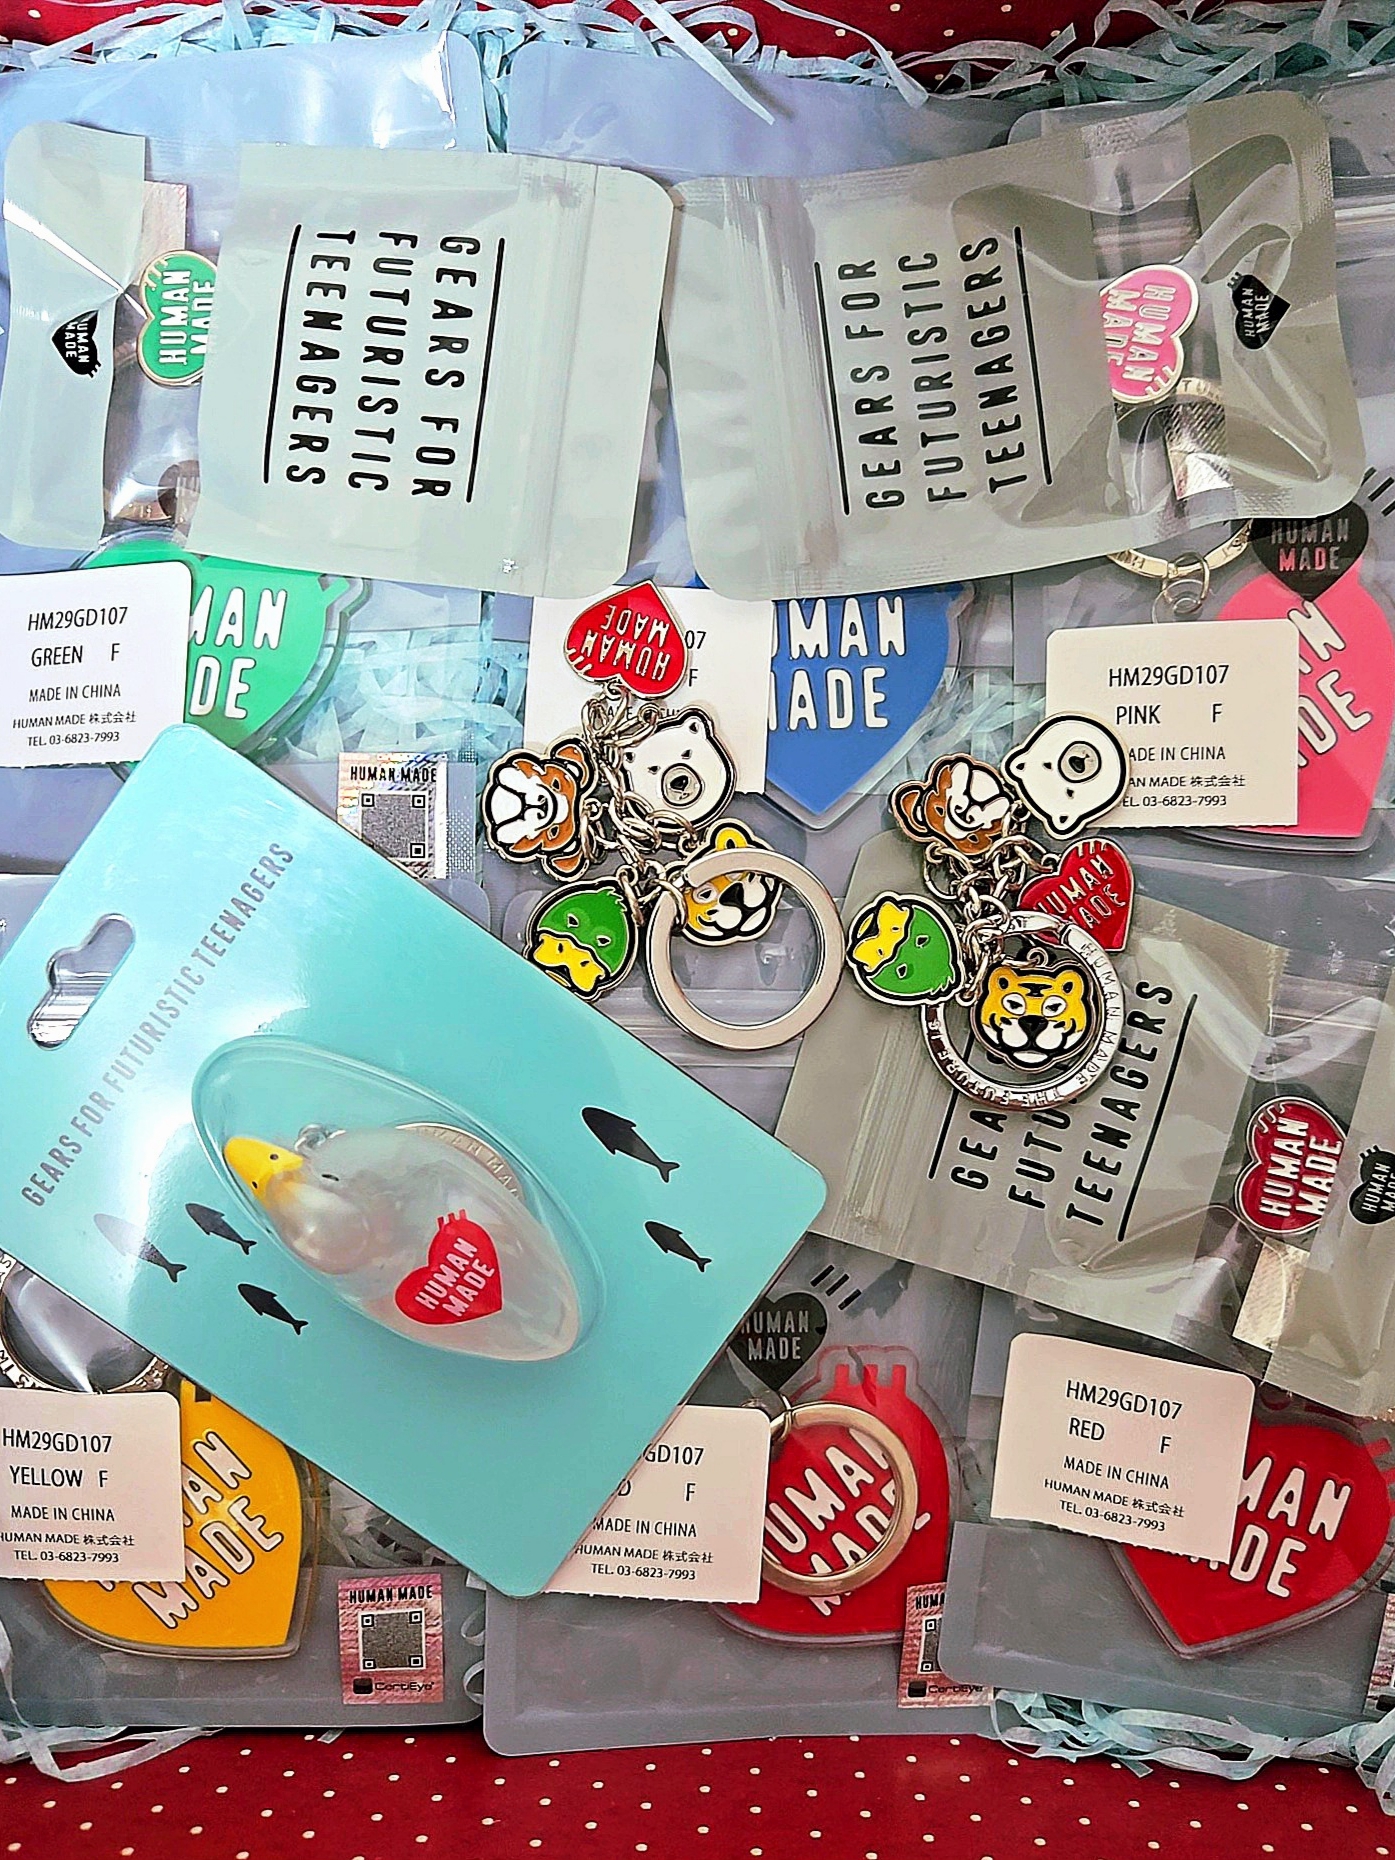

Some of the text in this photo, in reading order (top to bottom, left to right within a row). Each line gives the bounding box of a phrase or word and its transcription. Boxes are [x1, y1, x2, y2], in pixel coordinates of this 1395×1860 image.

[159, 271, 192, 364] HUMAN
[1241, 288, 1256, 337] HUMAN
[1254, 295, 1271, 334] MADE
[1122, 284, 1176, 382] HUMAN
[286, 230, 356, 484] TEENAGERS
[348, 231, 418, 491] FUTURISTIC
[412, 236, 480, 497] GEARS FOR
[959, 237, 1027, 494] TEENAGERS
[838, 260, 905, 509] GEARS FOR
[898, 252, 967, 502] FUTURISTIC
[1270, 517, 1349, 545] HUMAN
[1278, 546, 1340, 572] MADE
[28, 606, 128, 631] HM29GD107
[601, 604, 670, 648] MADE
[771, 596, 907, 661] MAN
[31, 643, 120, 667] GREEN F
[581, 629, 671, 681] HUMAN
[29, 684, 121, 702] MADE IN CHINA
[189, 655, 257, 720] DE
[688, 669, 699, 687] F
[1109, 664, 1229, 687] HM29GD107
[13, 711, 137, 728] HUMAN MADE 株式会社
[1116, 703, 1223, 725] PINK F
[1299, 670, 1372, 756] DE
[49, 732, 120, 745] 03-6823-7993
[1129, 746, 1226, 761] ADE IN CHINA
[350, 765, 397, 782] HUMAN
[1150, 776, 1186, 788] MADE
[1121, 796, 1227, 807] EL. 03-6823-7993
[21, 842, 294, 1206] GEARS FOR FUTURISTIC TEENAGERS
[1066, 982, 1173, 1226] TEENAGERS
[951, 1110, 1007, 1190] GEA
[1259, 1117, 1309, 1217] HUMAN
[1296, 1136, 1342, 1216] MADE
[1361, 1162, 1391, 1212] HUMAN
[415, 1237, 478, 1310] HUMAN
[443, 1259, 495, 1317] MADE
[748, 1336, 802, 1361] MADE
[1066, 1380, 1183, 1420] HM29GD107
[3, 1428, 112, 1453] HM29GD107
[1069, 1417, 1172, 1454] RED F
[643, 1444, 704, 1466] GD107
[10, 1465, 108, 1487] YELLOW F
[1063, 1456, 1169, 1490] MADE IN CHINA
[685, 1482, 696, 1502] F
[763, 1427, 889, 1556] UMA
[1044, 1478, 1185, 1518] HUMAN MADE 株式会社
[11, 1505, 115, 1522] MADE IN CHINA
[636, 1520, 650, 1535] IN
[654, 1521, 697, 1538] CHINA
[1060, 1499, 1166, 1532] TEL. 03-6823-7993
[14, 1550, 119, 1562] TEL. 03-6823-7993
[45, 1534, 80, 1545] MADE
[83, 1534, 135, 1546] 株式会社
[624, 1548, 659, 1560] MADE
[662, 1550, 714, 1564] 株式会社
[133, 1496, 283, 1629] MADE
[592, 1563, 696, 1581] TEL. 03-6823-7993
[1229, 1524, 1307, 1598] DE
[349, 1584, 433, 1604] HUMAN MADE
[915, 1592, 945, 1610] HUMA
